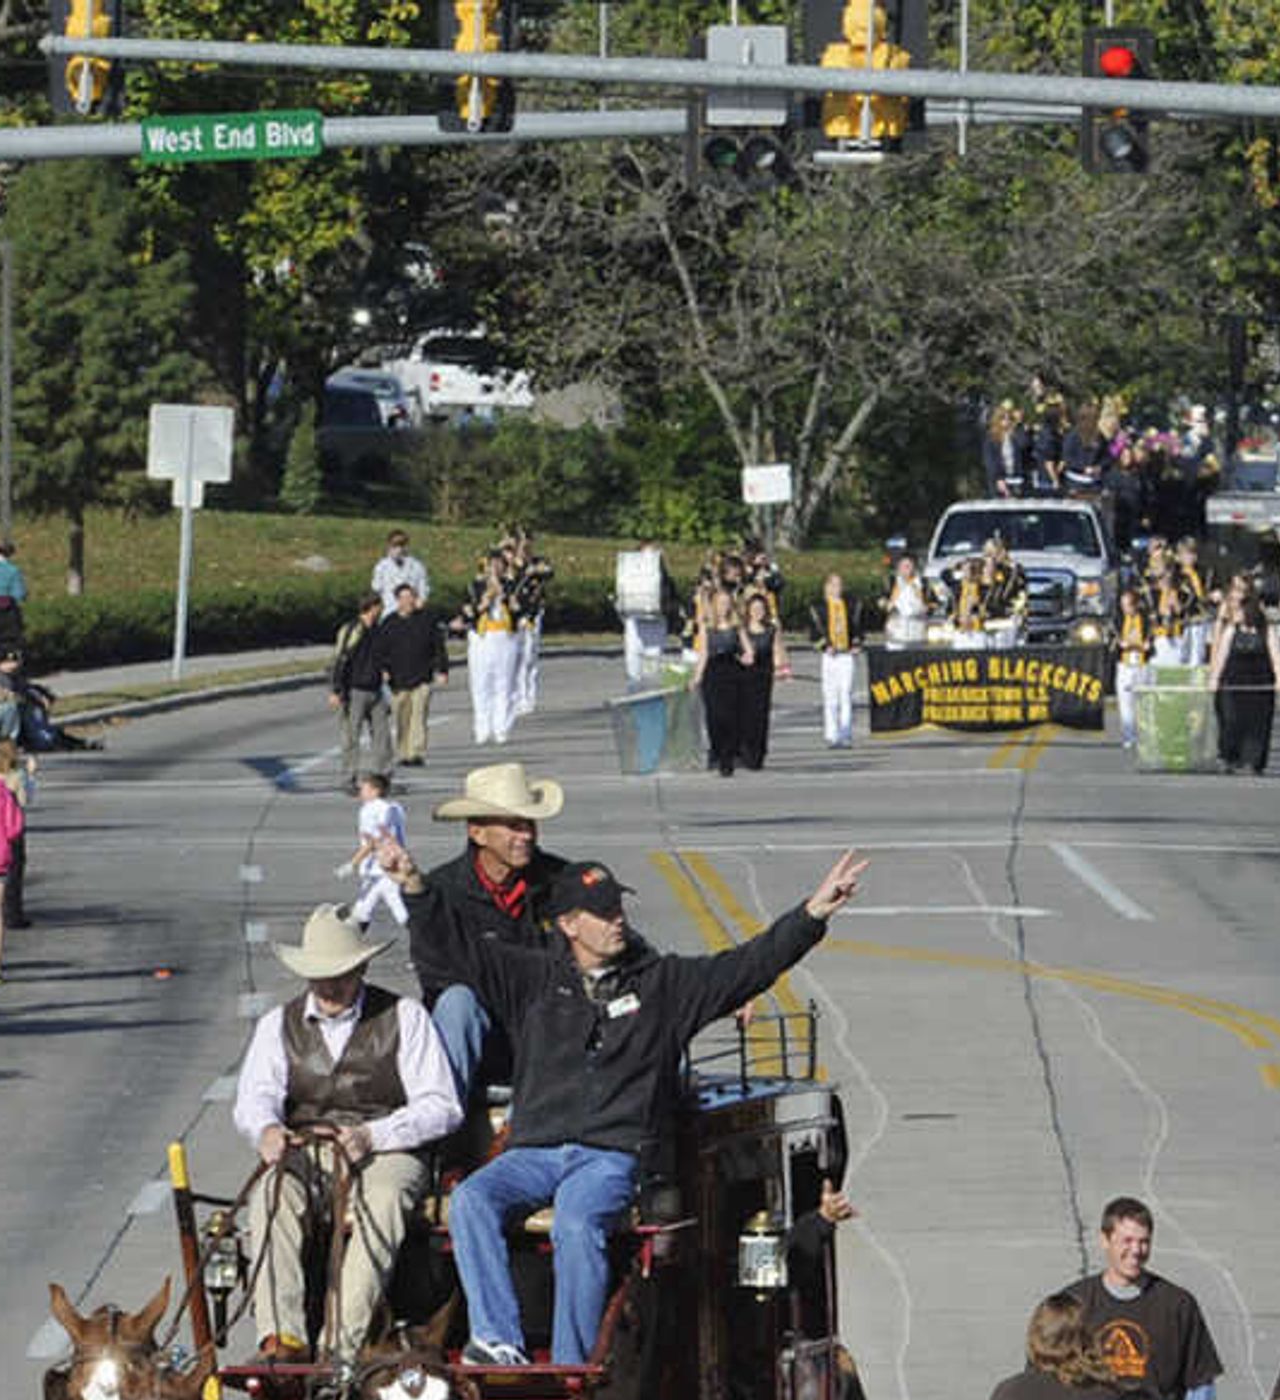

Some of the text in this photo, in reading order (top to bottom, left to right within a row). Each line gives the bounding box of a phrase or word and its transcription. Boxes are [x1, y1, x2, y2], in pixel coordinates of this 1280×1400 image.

[146, 121, 316, 153] West End Blvd
[871, 655, 1102, 705] MARCHING BLACKCATS
